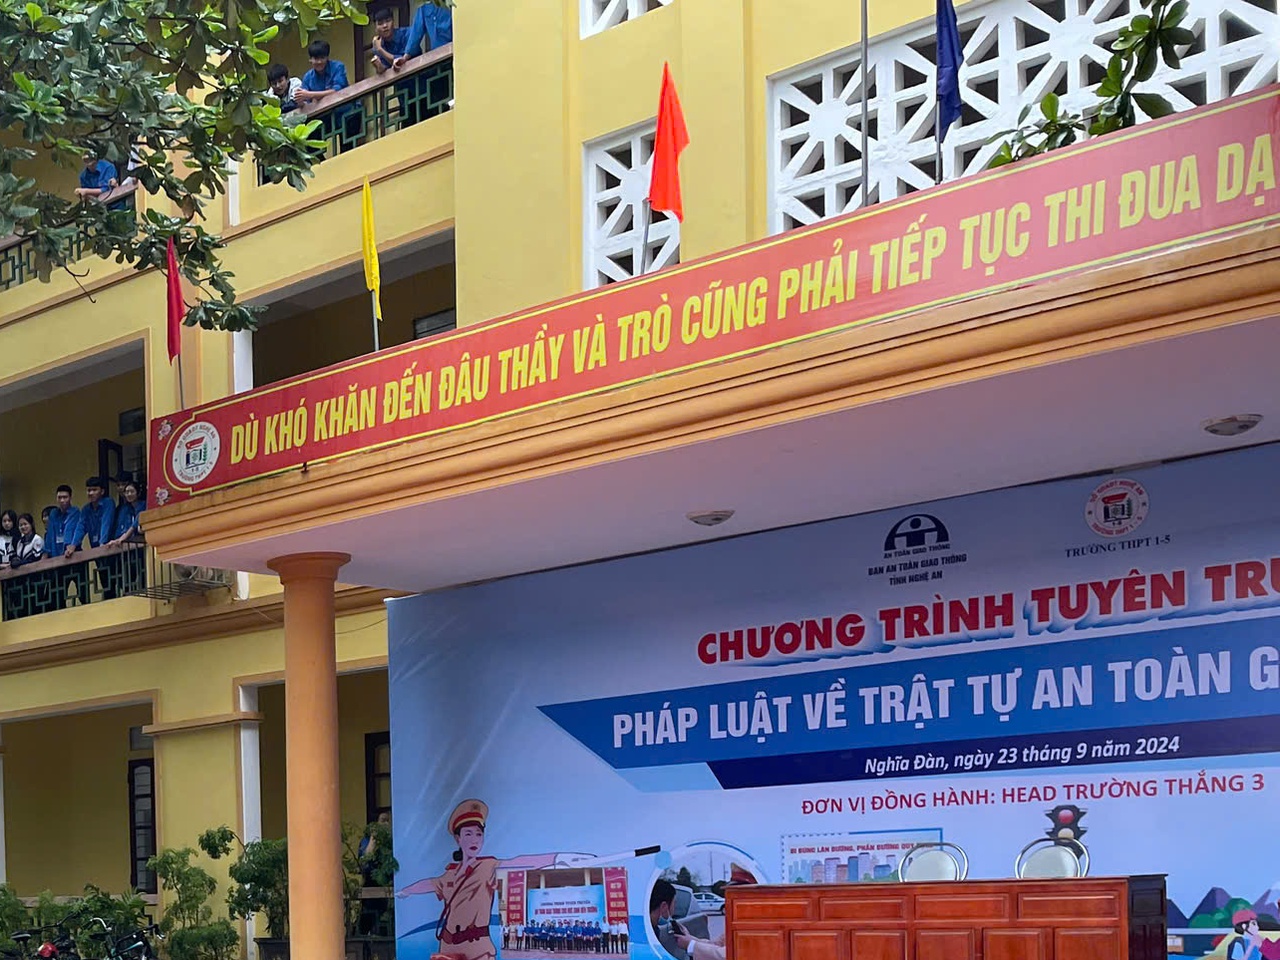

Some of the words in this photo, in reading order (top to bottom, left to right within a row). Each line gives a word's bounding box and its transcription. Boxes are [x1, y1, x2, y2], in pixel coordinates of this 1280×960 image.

[230, 422, 259, 464] DÙ
[264, 400, 308, 455] KHÓ
[314, 387, 377, 442] KHĂN
[382, 360, 432, 425] ĐẾN
[439, 353, 489, 409] ĐÂU
[499, 323, 565, 393] THẦY
[573, 313, 608, 374] VÀ
[617, 293, 671, 362] TRÒ
[681, 276, 768, 345] CŨNG
[777, 238, 858, 319] PHẢI
[870, 213, 947, 293] TIẾP
[960, 202, 1030, 276] TỤC
[1045, 181, 1107, 247] THI
[1118, 155, 1200, 226] ĐUA
[1216, 133, 1276, 207] DẠ
[886, 565, 897, 574] AN
[899, 561, 919, 572] TOÀN
[921, 558, 939, 568] GIAO
[940, 554, 967, 566] THÔNG
[1065, 542, 1116, 558] TRƯỜNG
[1119, 537, 1151, 551] THPT
[931, 570, 943, 580] AN
[697, 613, 866, 665] CHƯƠNG
[879, 593, 1014, 641] TRÌNH
[1031, 568, 1186, 623] TUYÊN
[613, 702, 698, 749] PHÁP
[709, 691, 792, 743] LUẬT
[803, 677, 847, 730] VỀ
[859, 674, 954, 729] TRẬT
[967, 666, 1022, 722] TỰ
[1031, 665, 1092, 710] AN
[1108, 646, 1231, 703] TOÀN
[865, 756, 909, 776] Nghĩa
[913, 752, 949, 771] Đàn,
[954, 749, 993, 770] ngày
[998, 747, 1018, 764] 23
[1022, 743, 1072, 763] tháng
[1076, 743, 1087, 759] 9
[1092, 740, 1130, 757] năm
[1135, 736, 1180, 754] 2024
[802, 797, 843, 814] ĐƠN
[848, 797, 866, 814] VỊ
[871, 789, 926, 810] ĐỒNG
[933, 787, 995, 807] HÀNH:
[1002, 786, 1057, 803] HEAD
[1062, 778, 1158, 800] TRƯỜNG
[1164, 769, 1244, 796] THẮNG
[1251, 773, 1265, 790] 3
